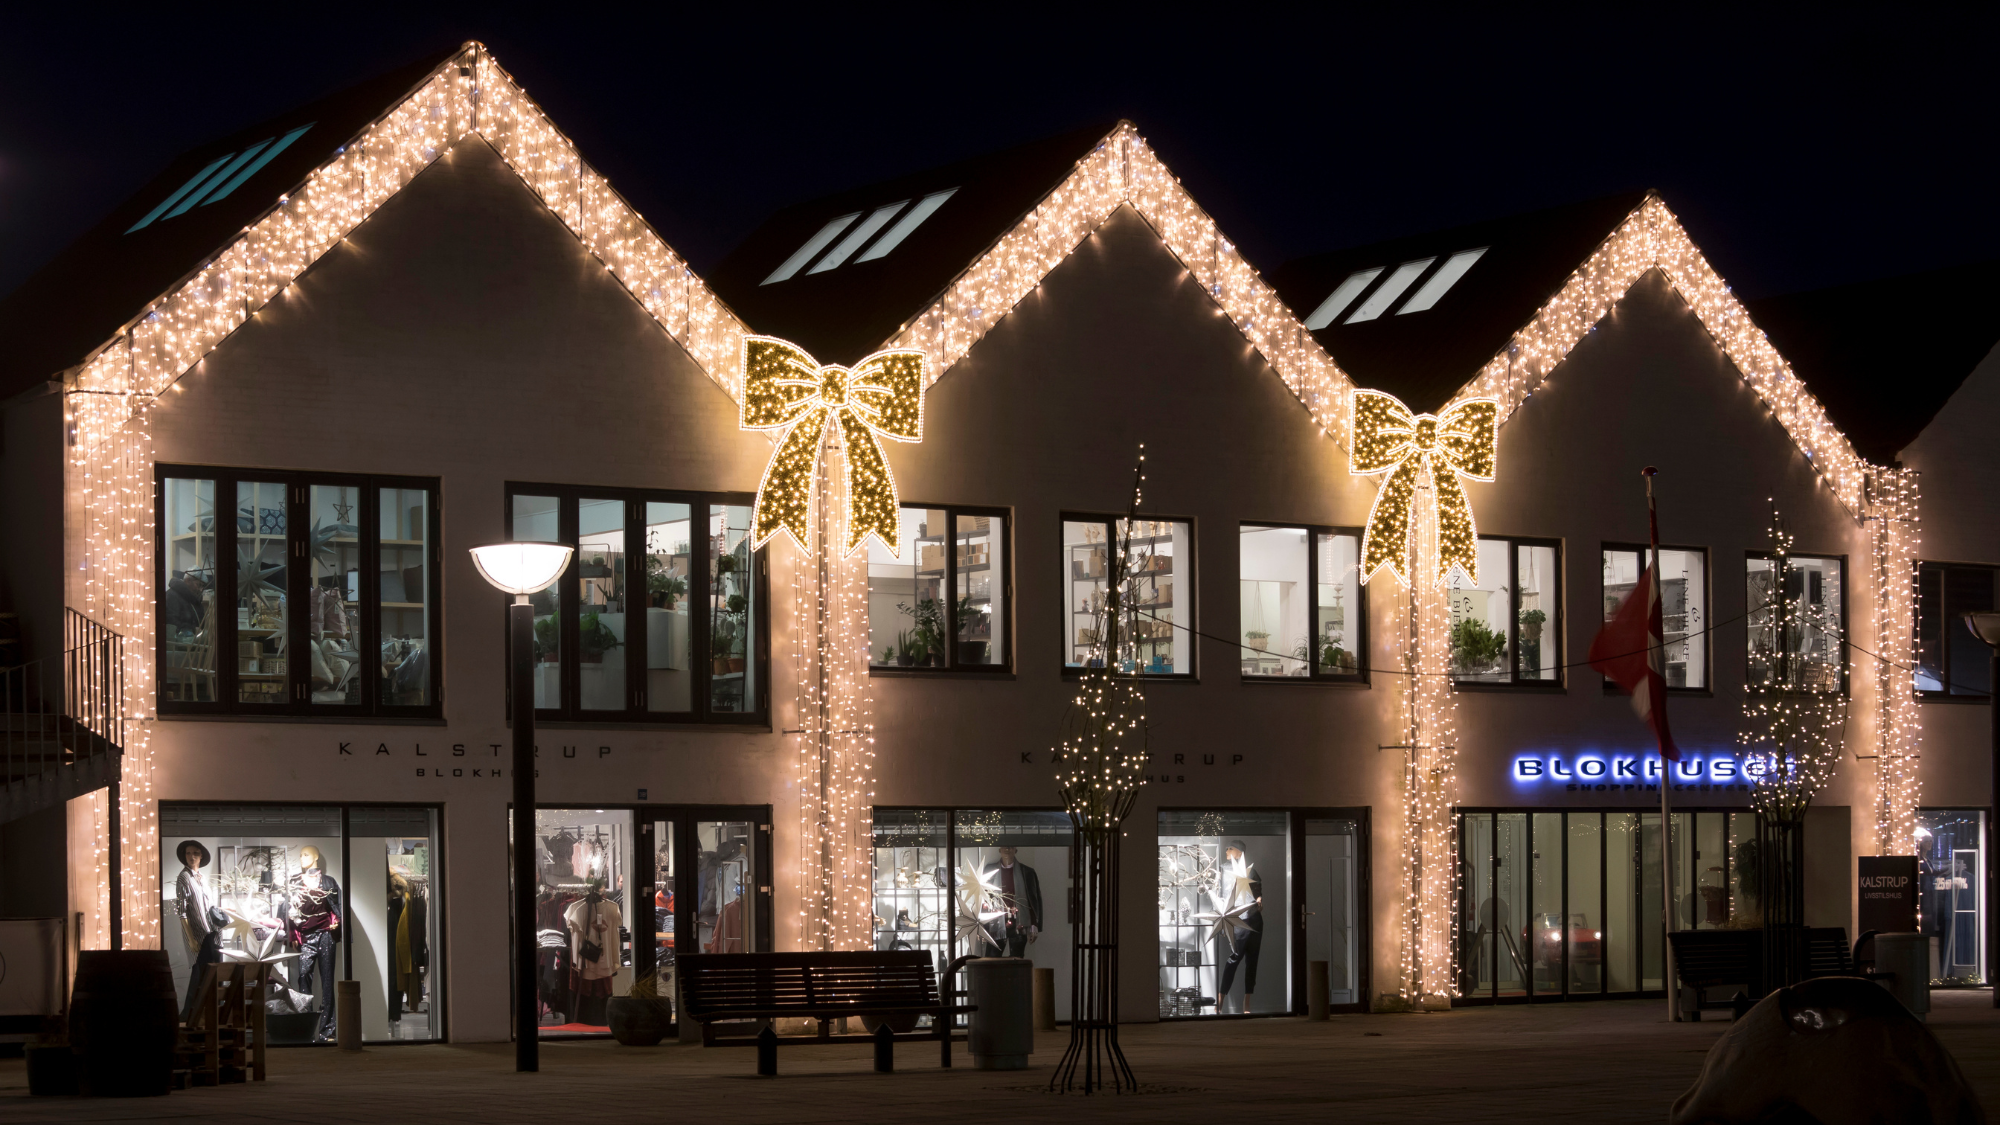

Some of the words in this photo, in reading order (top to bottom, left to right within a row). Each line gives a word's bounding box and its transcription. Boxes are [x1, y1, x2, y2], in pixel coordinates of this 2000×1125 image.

[416, 768, 539, 778] BLOKH
[1566, 783, 1749, 792] SHOPPINCENTER
[1860, 875, 1909, 888] KALSTRUP
